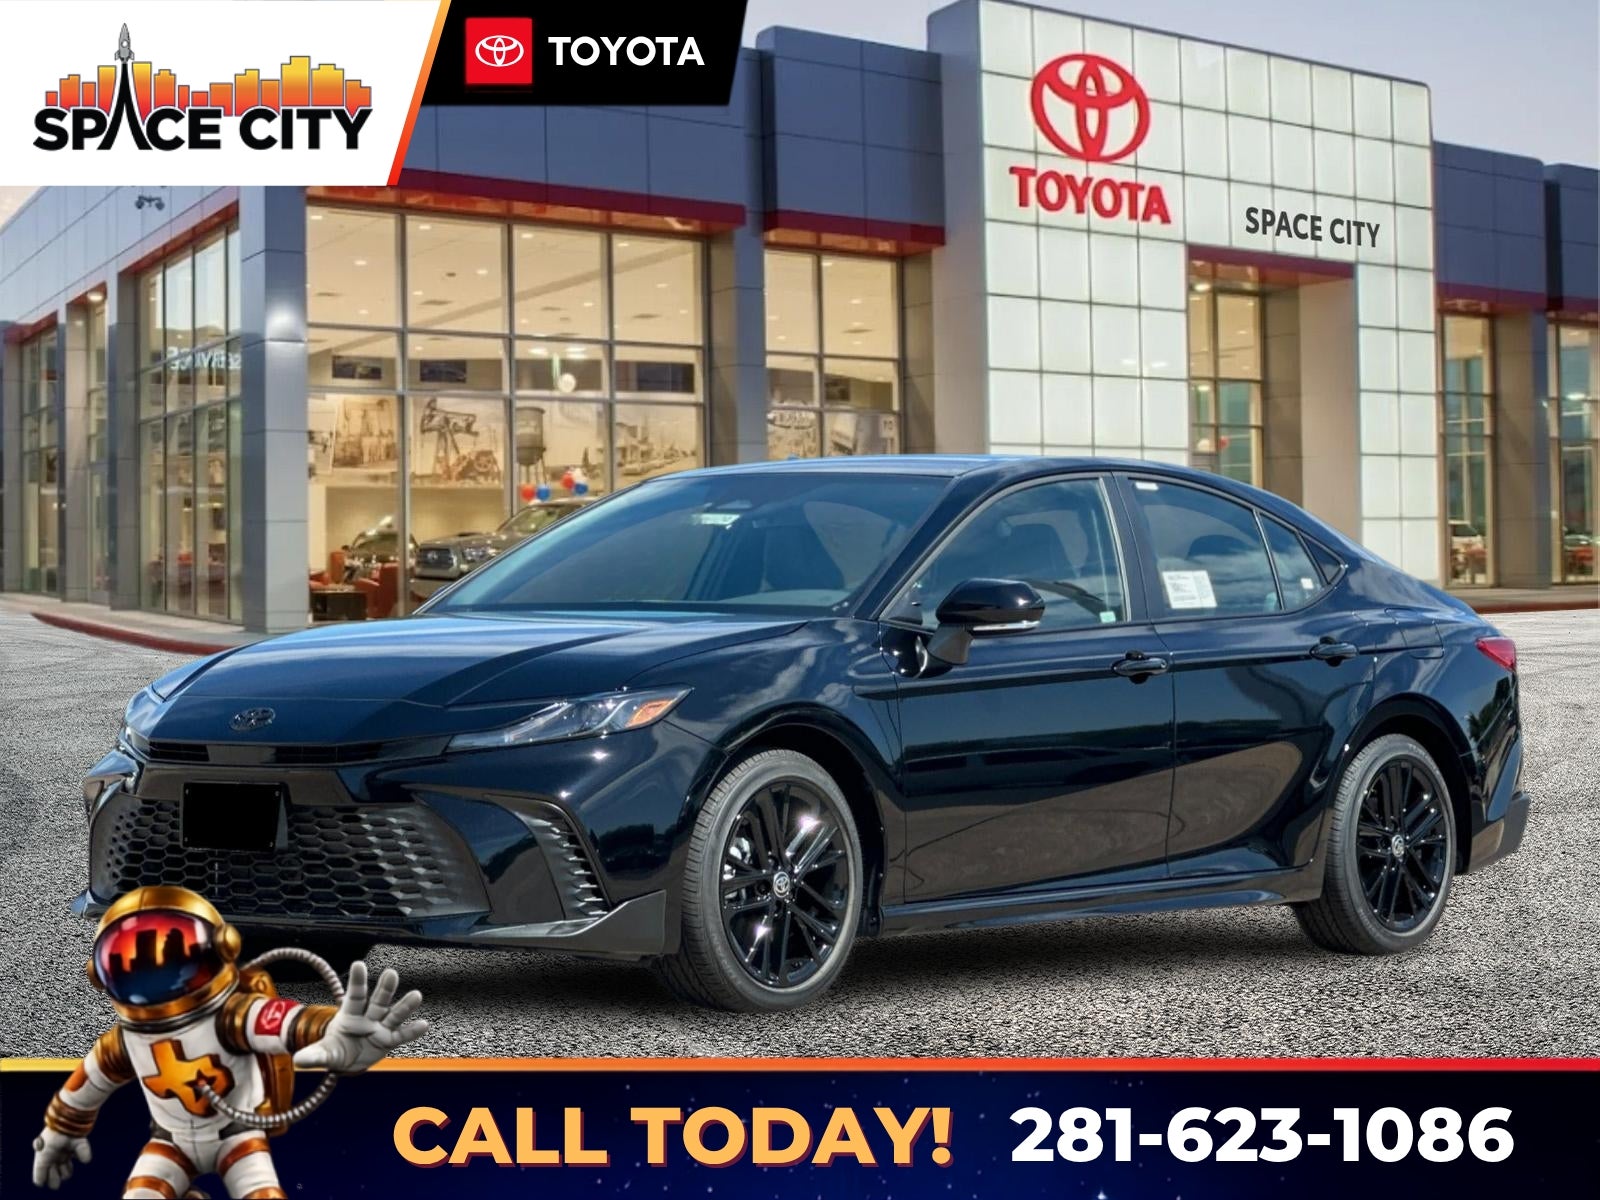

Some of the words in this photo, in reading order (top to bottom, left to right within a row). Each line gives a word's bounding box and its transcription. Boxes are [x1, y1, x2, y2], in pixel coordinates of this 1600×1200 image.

[1009, 166, 1171, 225] TOYOTA
[1244, 206, 1323, 242] SPACE
[1329, 217, 1381, 248] CITY
